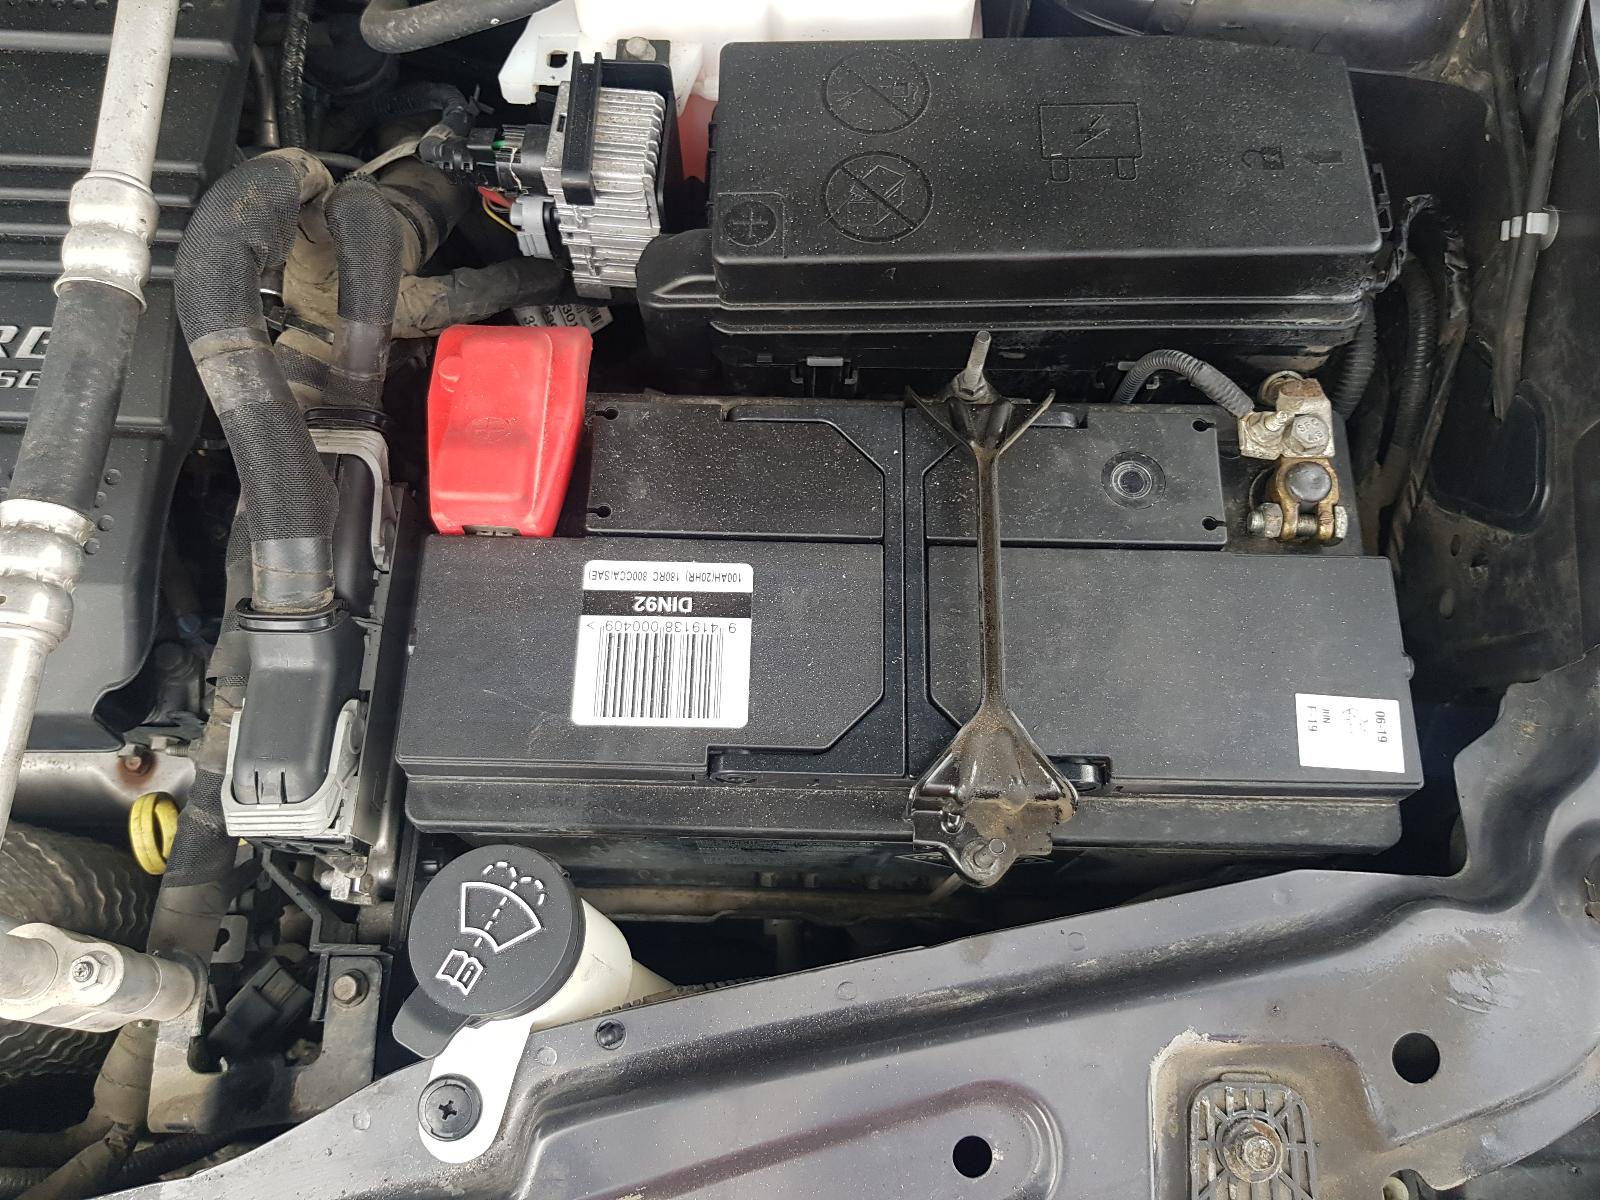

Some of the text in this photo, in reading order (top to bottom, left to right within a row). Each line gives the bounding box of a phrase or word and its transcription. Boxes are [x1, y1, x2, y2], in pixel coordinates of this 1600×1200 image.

[588, 570, 742, 583] 100AH(20HR) 180RC 800CCA(SAE)
[633, 596, 693, 612] DIN92
[605, 620, 658, 632] 000409
[665, 621, 719, 633] 419138
[728, 622, 737, 634] 9
